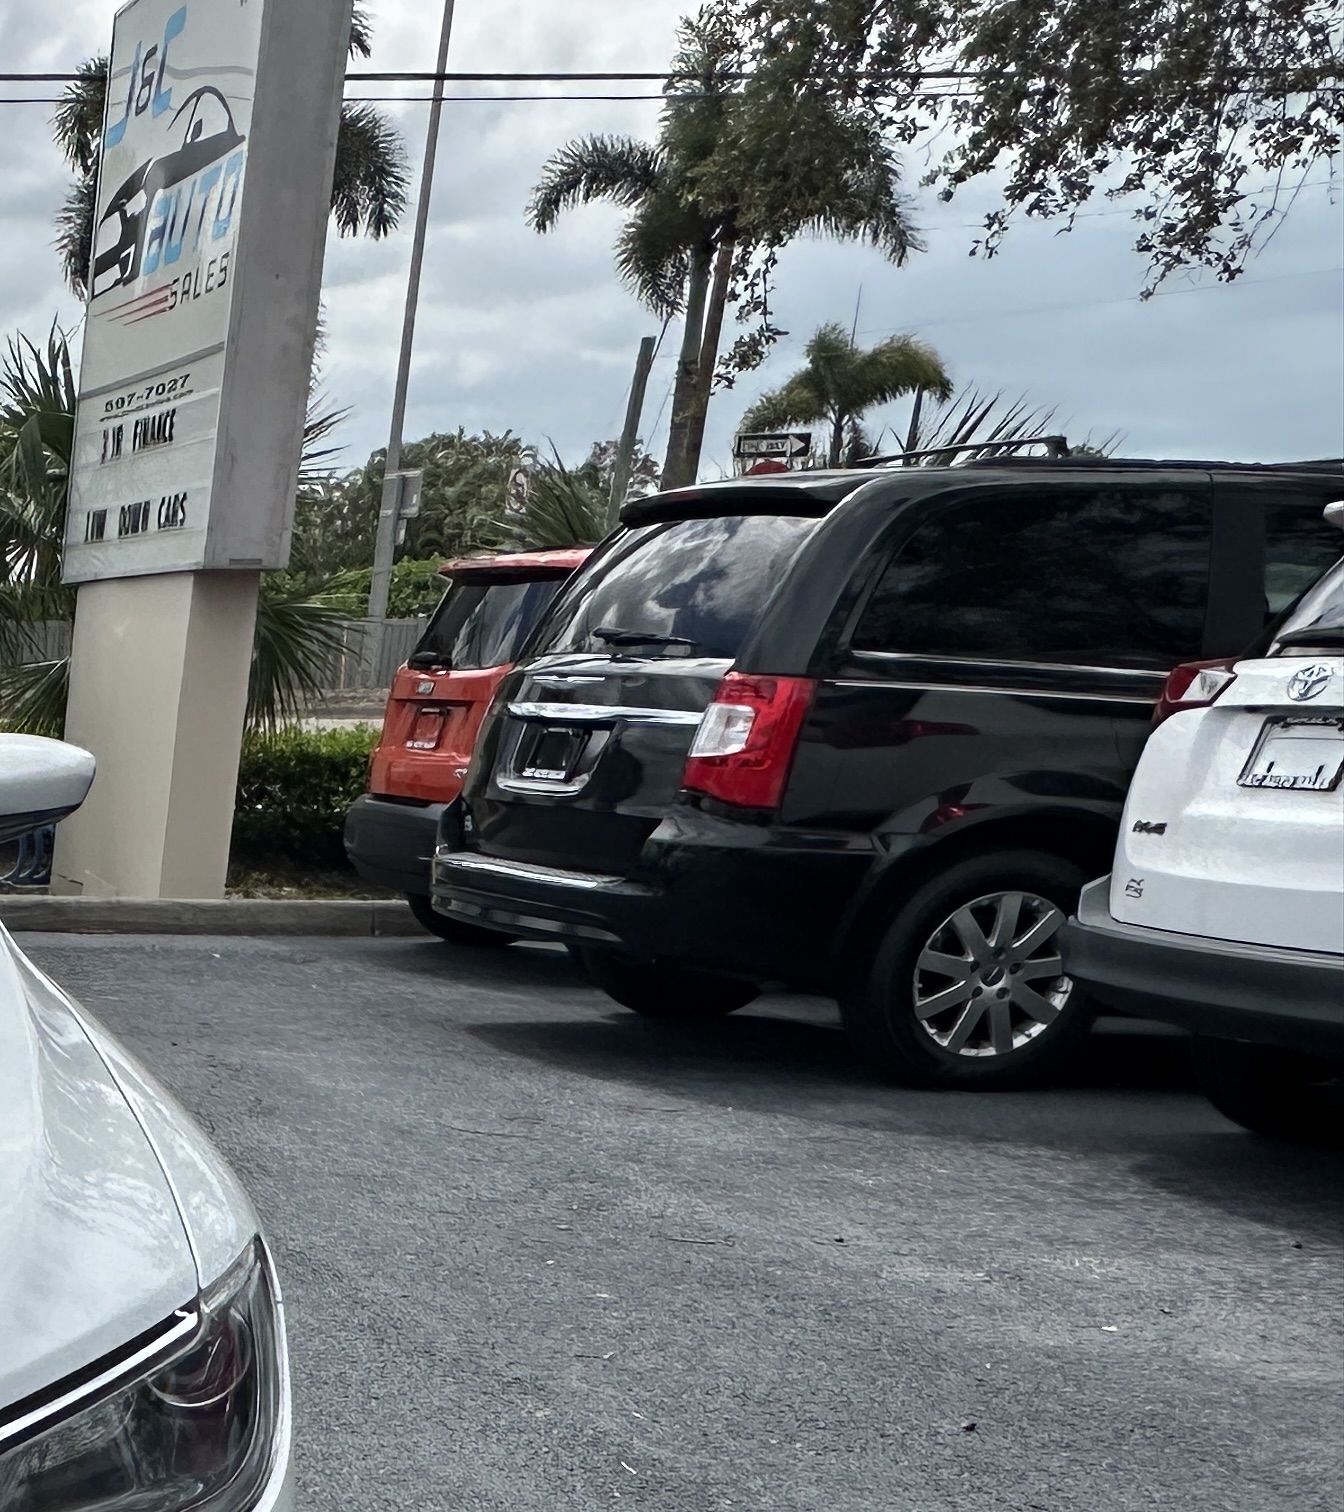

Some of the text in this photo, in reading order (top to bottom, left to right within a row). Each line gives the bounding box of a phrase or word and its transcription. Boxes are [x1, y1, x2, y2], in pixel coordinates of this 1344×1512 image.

[105, 4, 187, 148] J&C
[142, 149, 244, 277] AUTO
[169, 251, 230, 310] SALES
[158, 491, 188, 530] CARS
